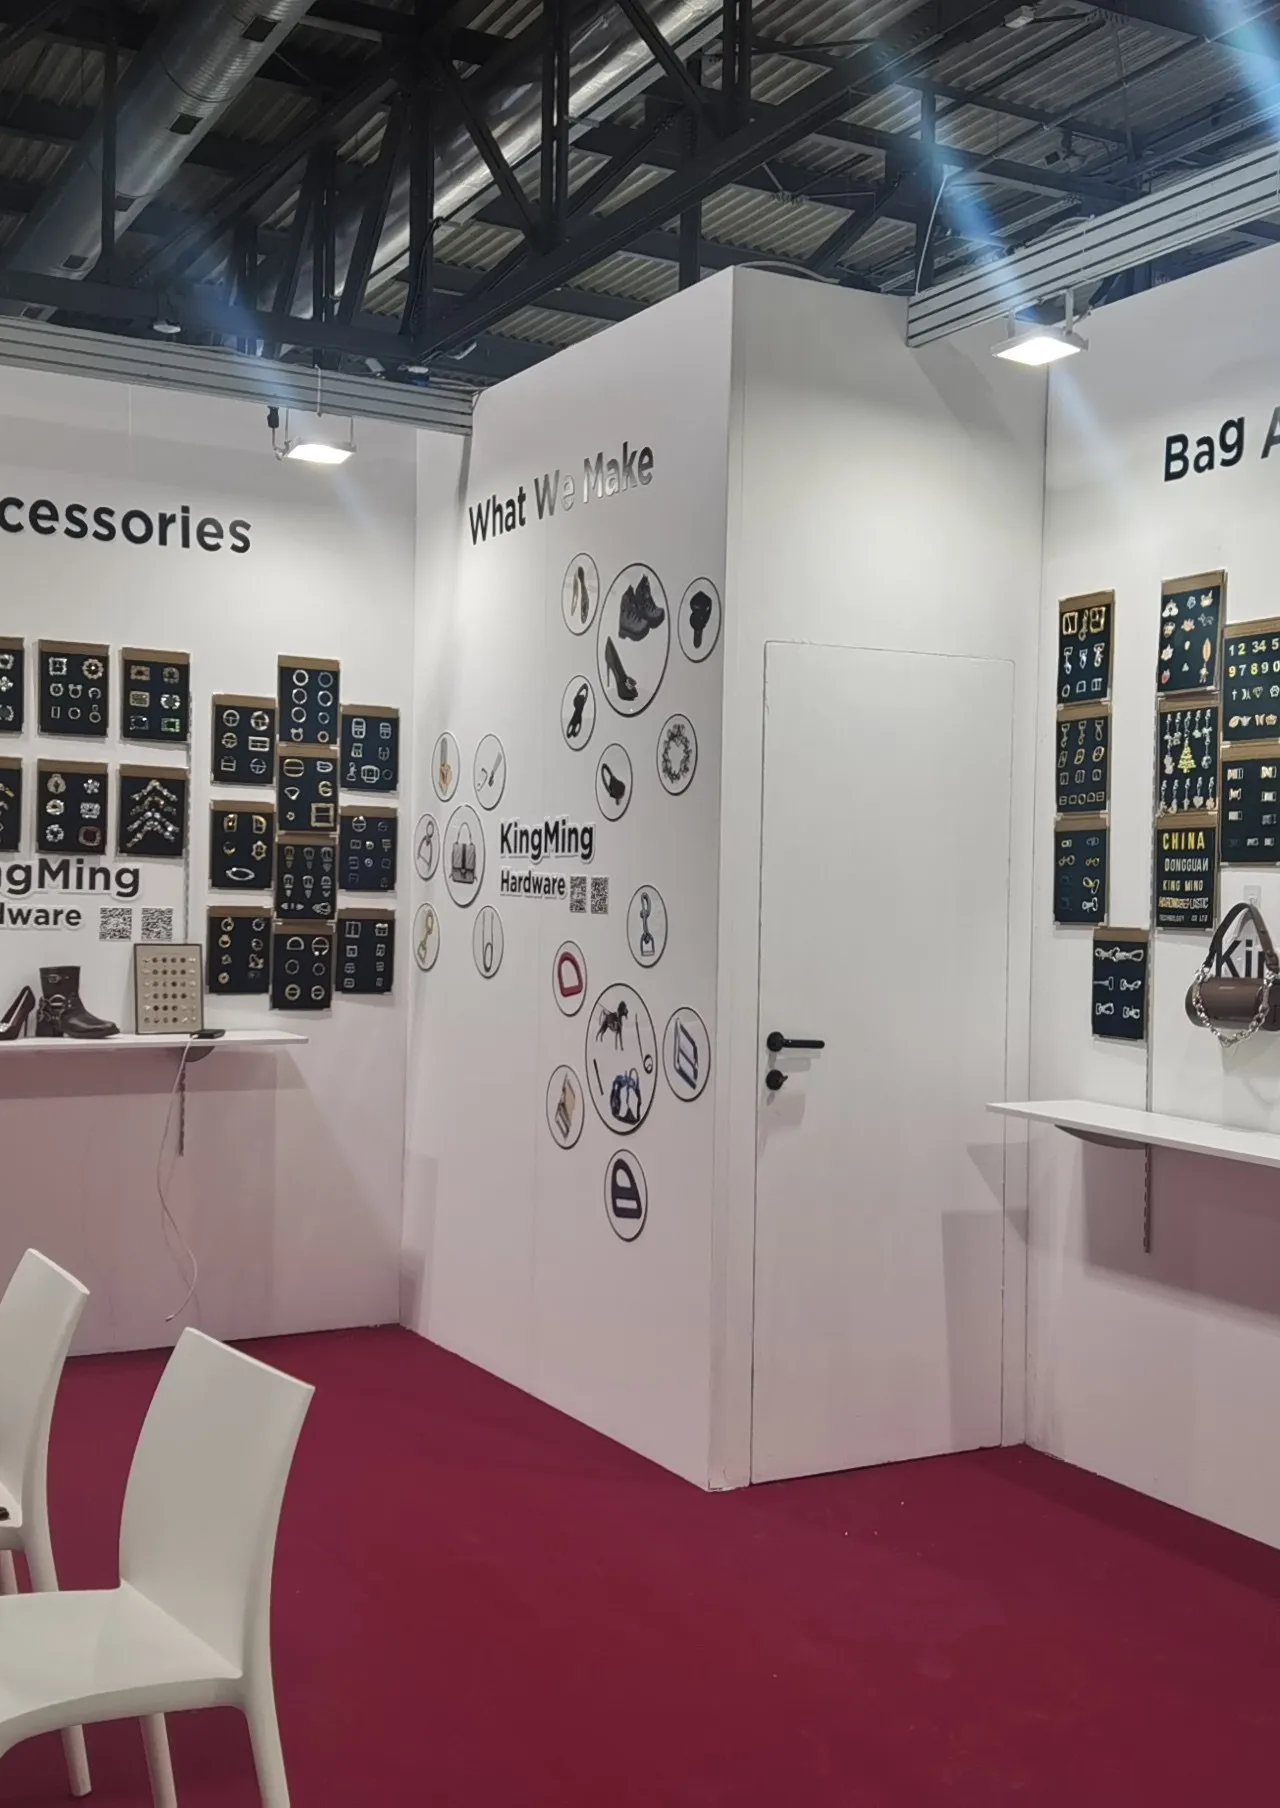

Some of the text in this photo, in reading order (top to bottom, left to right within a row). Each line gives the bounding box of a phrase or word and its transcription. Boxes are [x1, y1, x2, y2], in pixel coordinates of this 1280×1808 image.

[1163, 416, 1246, 483] Bag
[468, 440, 655, 546] What We Make
[500, 818, 594, 860] KingMing
[1162, 831, 1205, 850] CHINA
[1164, 857, 1209, 872] DONGGUAN
[500, 869, 566, 896] Hardware
[1162, 879, 1181, 892] KING
